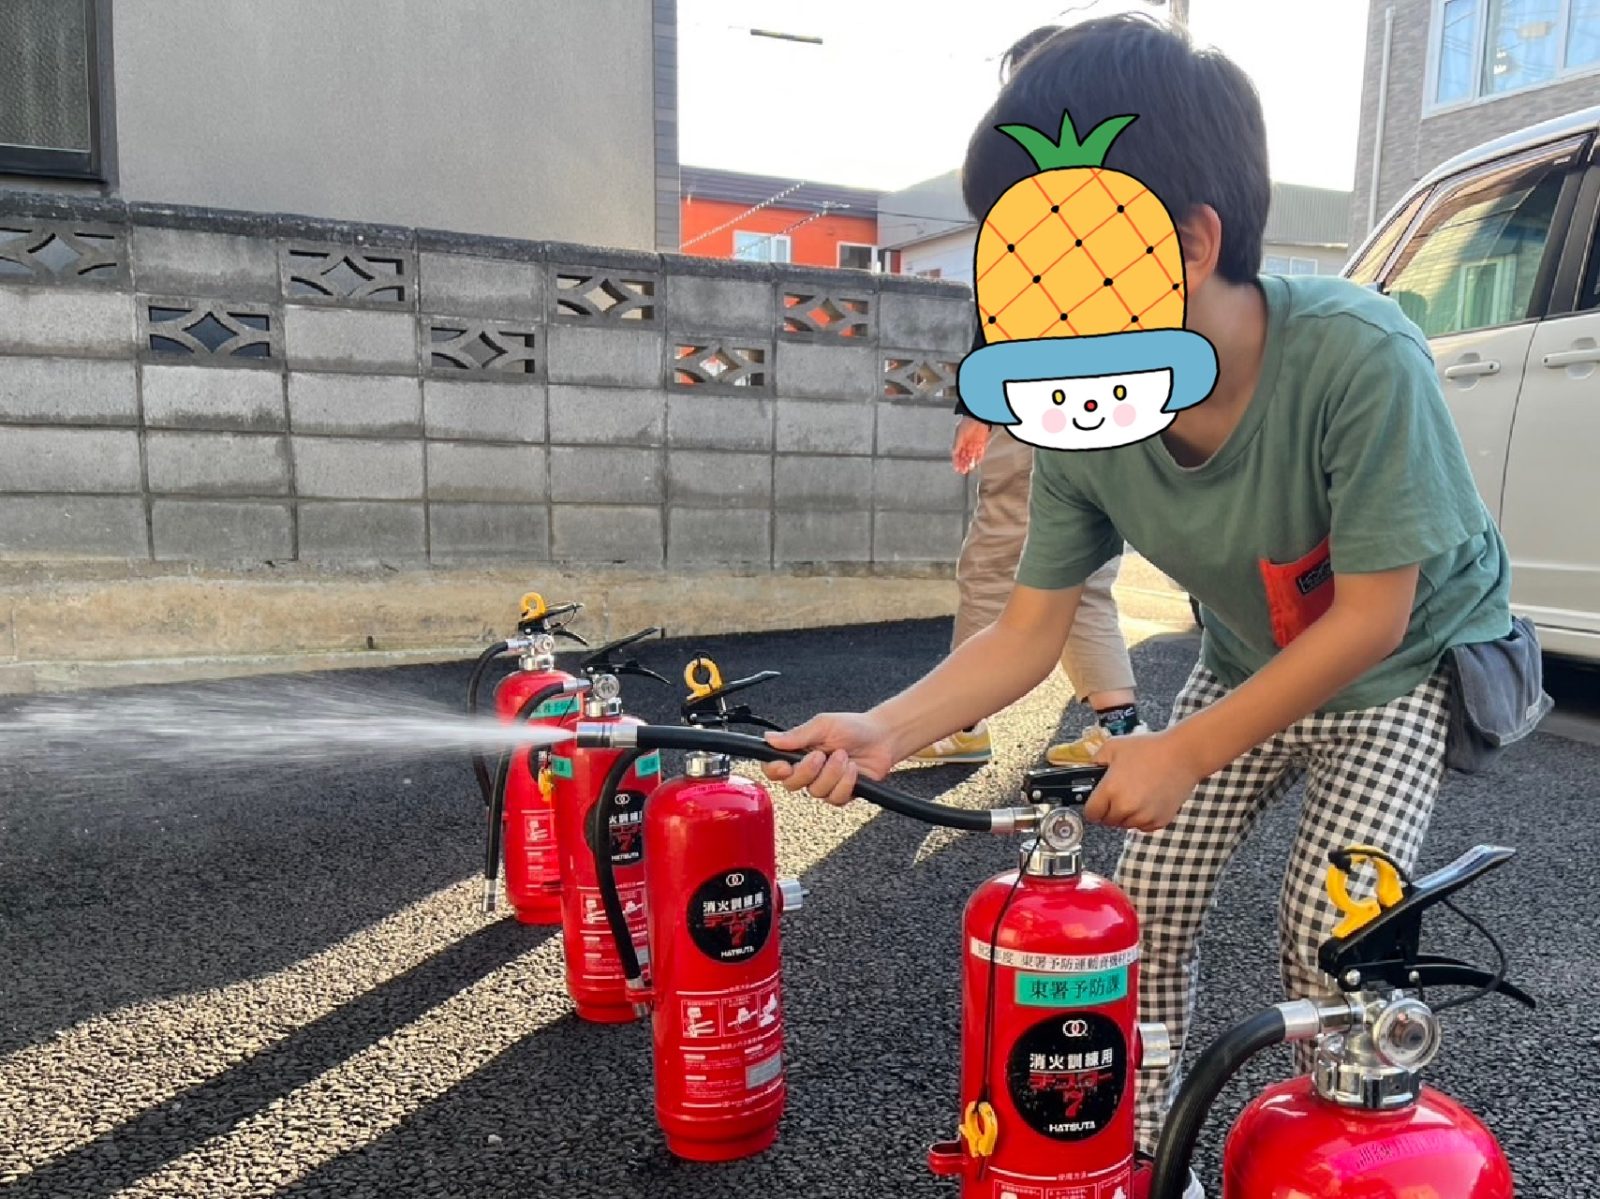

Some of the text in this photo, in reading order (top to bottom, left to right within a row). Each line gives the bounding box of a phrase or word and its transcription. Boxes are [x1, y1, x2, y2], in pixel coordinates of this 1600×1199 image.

[703, 892, 763, 913] 消火訓練用
[1031, 974, 1121, 999] 東署予防課
[1029, 1047, 1113, 1070] 消火訓練用
[1063, 1088, 1085, 1118] 7
[1048, 1121, 1096, 1132] HATSUTA
